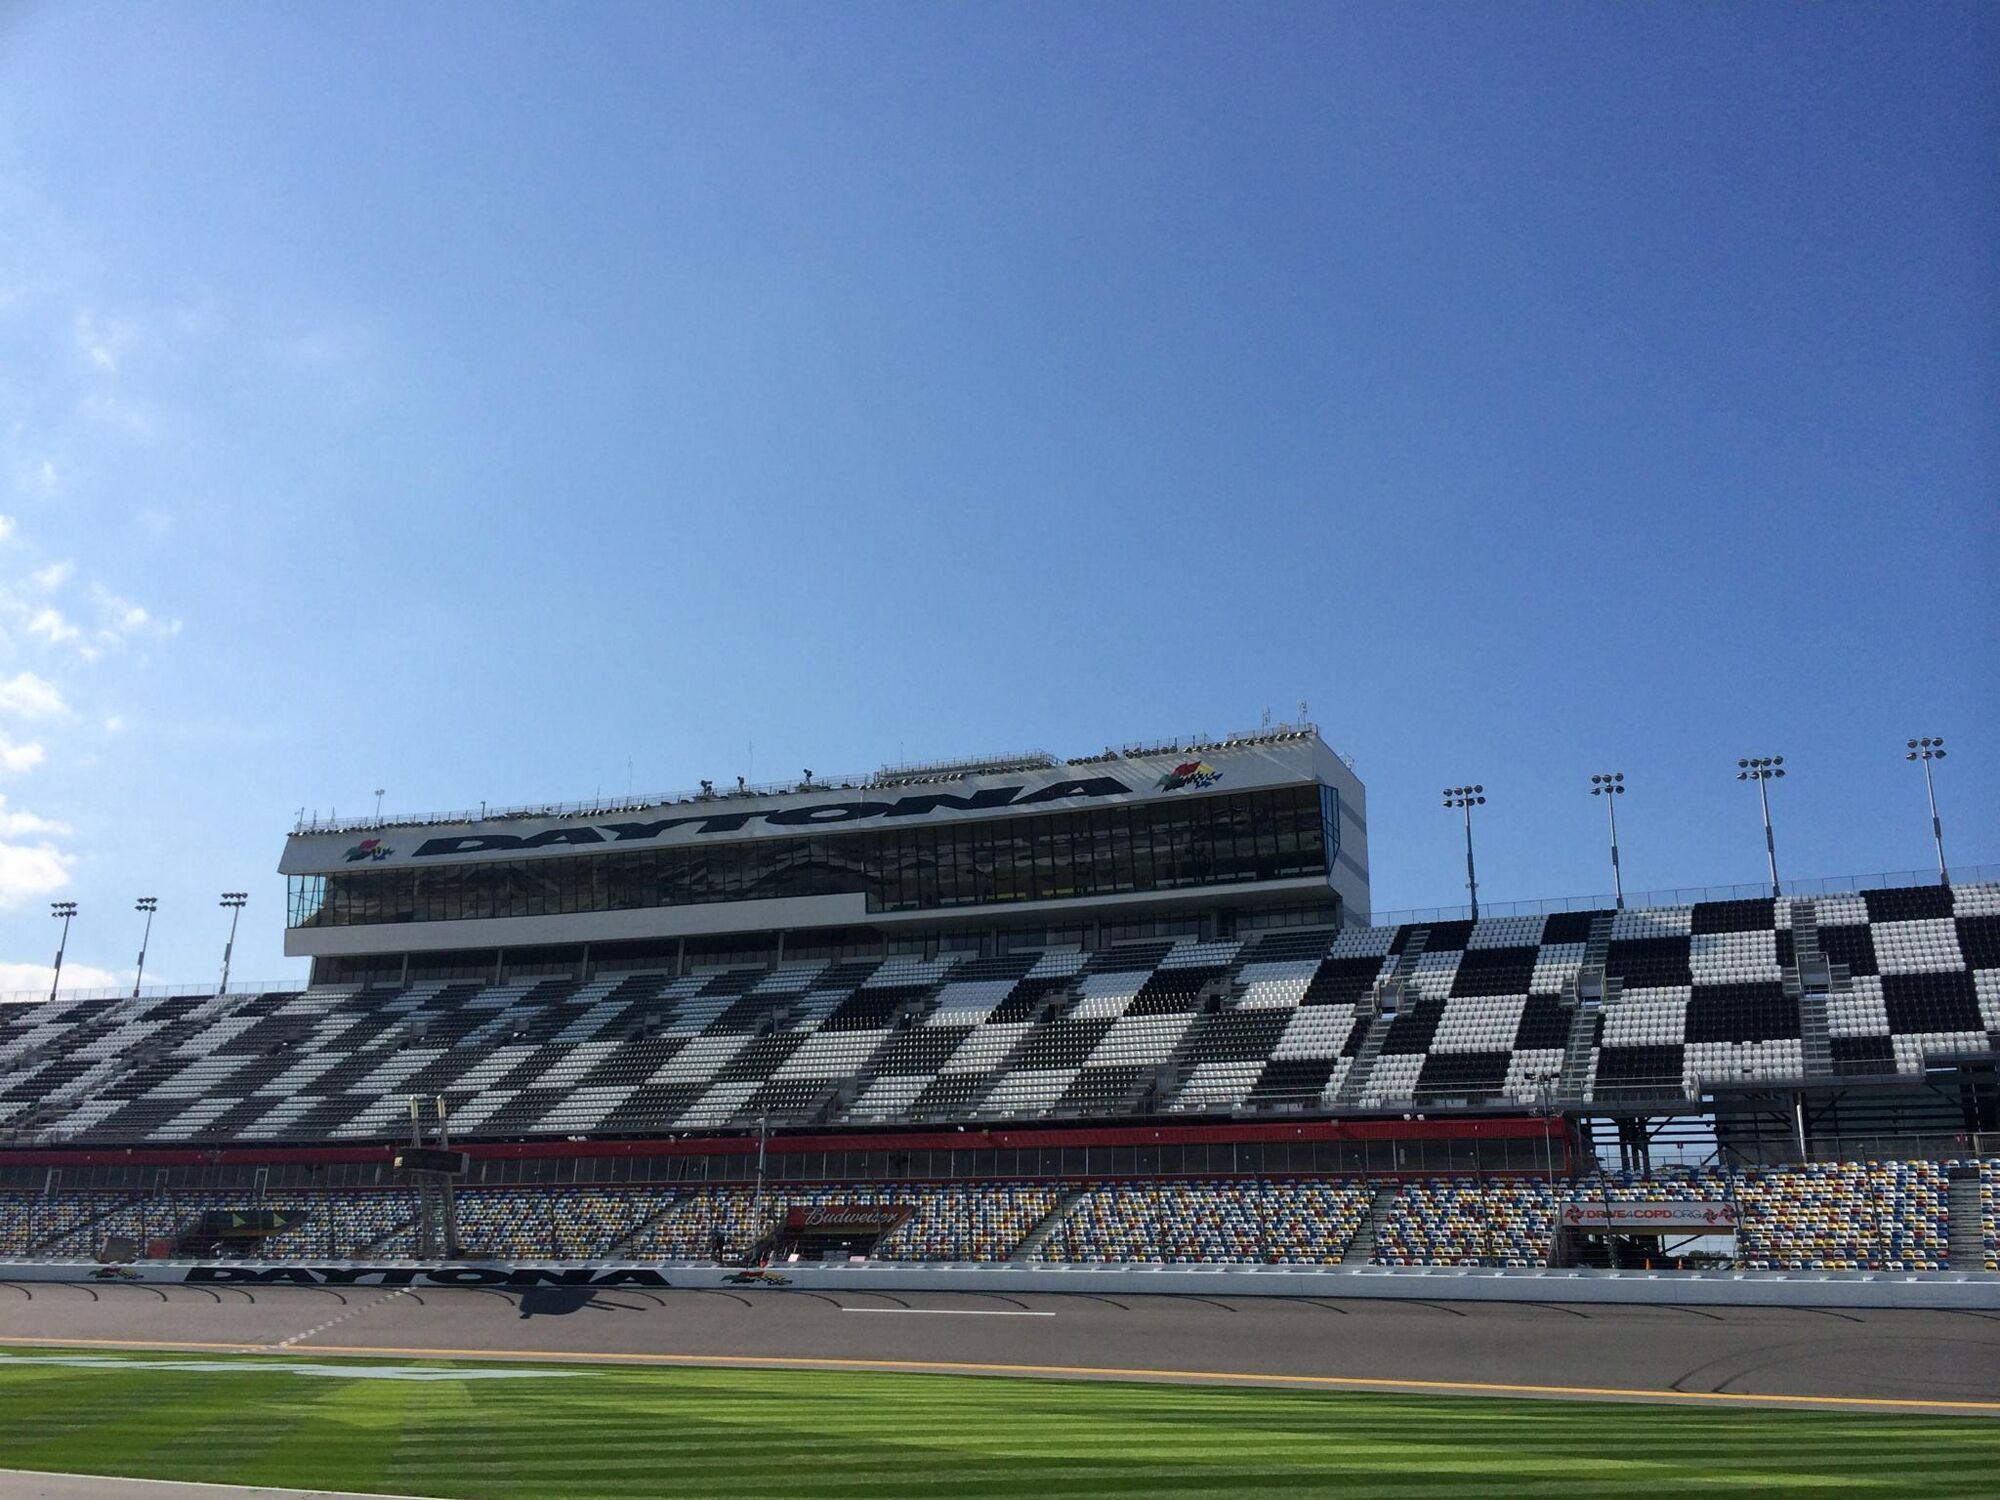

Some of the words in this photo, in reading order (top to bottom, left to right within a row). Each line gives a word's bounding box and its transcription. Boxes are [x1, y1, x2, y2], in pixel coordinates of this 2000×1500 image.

[411, 775, 1132, 857] DAYTONA
[803, 1206, 898, 1225] Budweiser
[183, 1267, 671, 1286] DAYTONA
